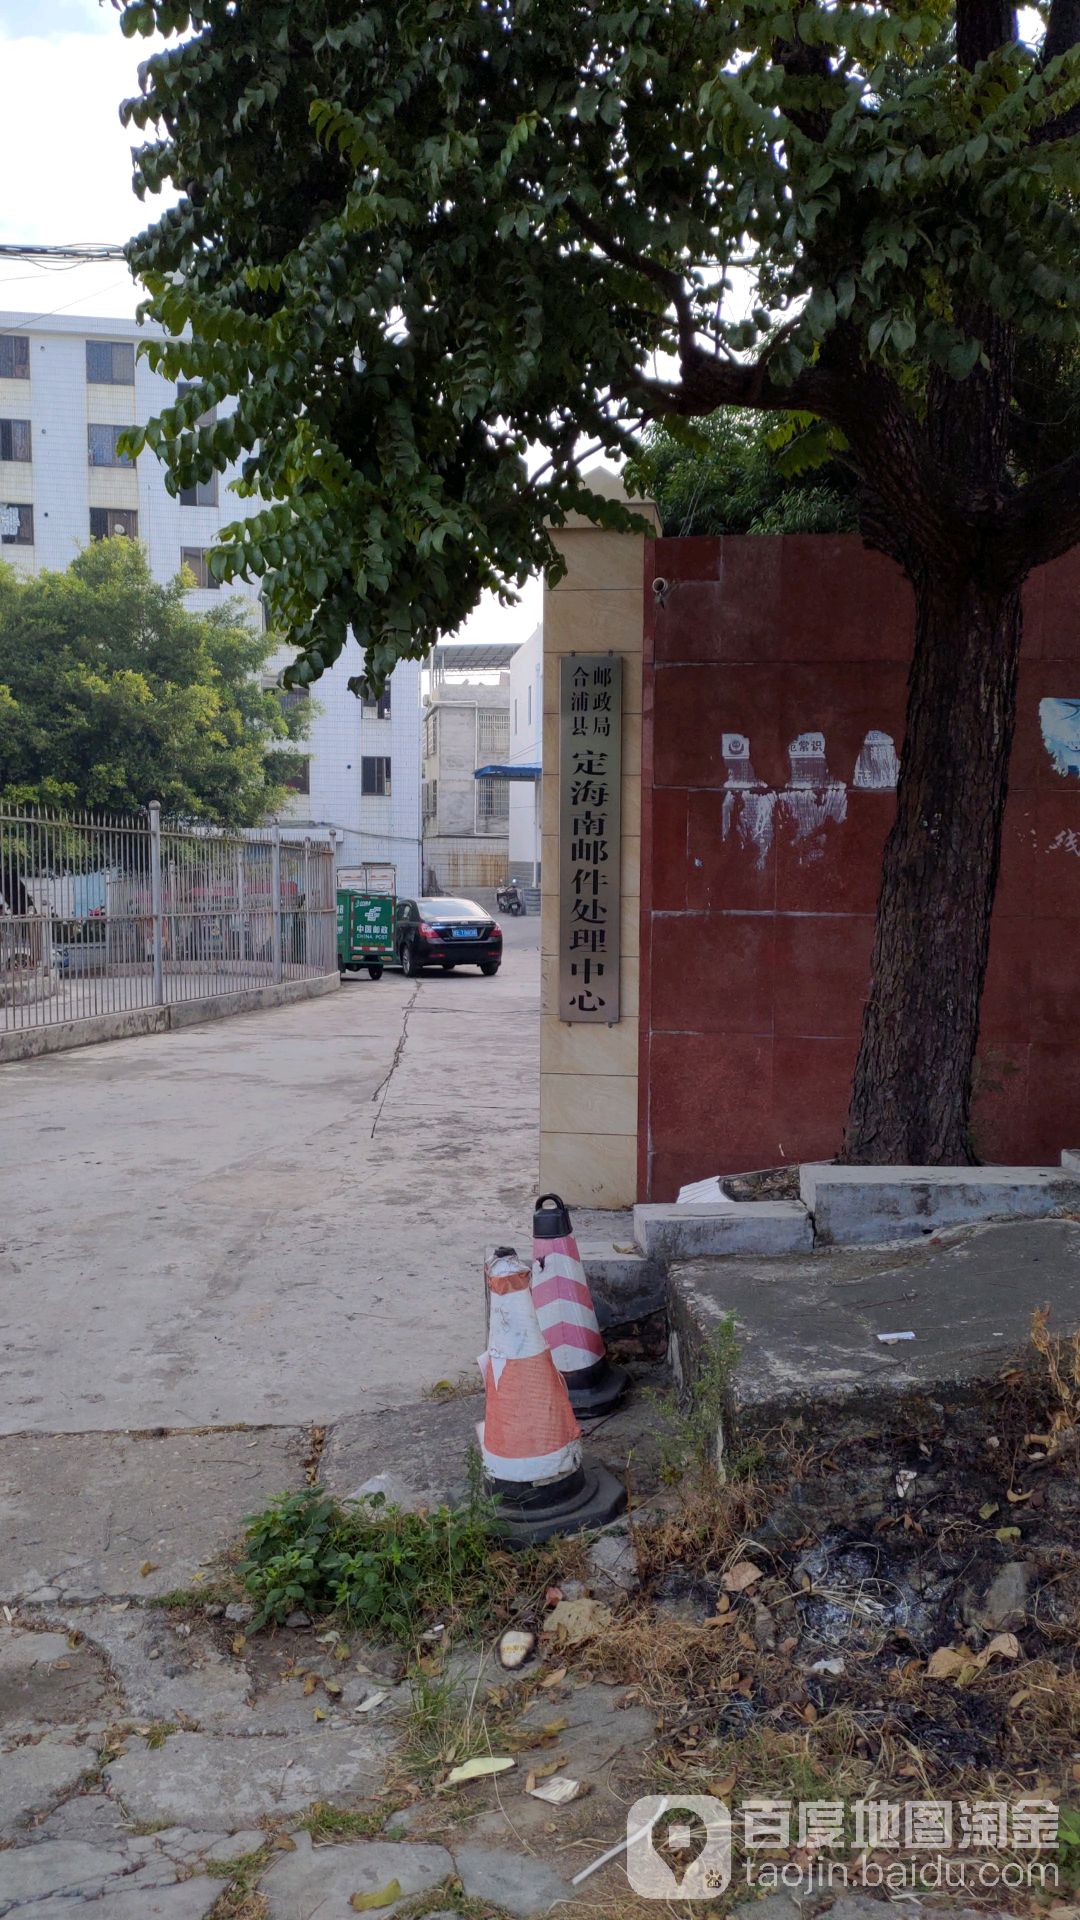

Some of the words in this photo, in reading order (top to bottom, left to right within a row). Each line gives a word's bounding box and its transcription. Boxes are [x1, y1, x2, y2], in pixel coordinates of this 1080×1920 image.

[571, 666, 590, 736] 合浦县
[593, 666, 612, 737] 邮政局
[569, 750, 609, 1012] 定海南邮件处理中心
[356, 924, 388, 934] 中国邮政
